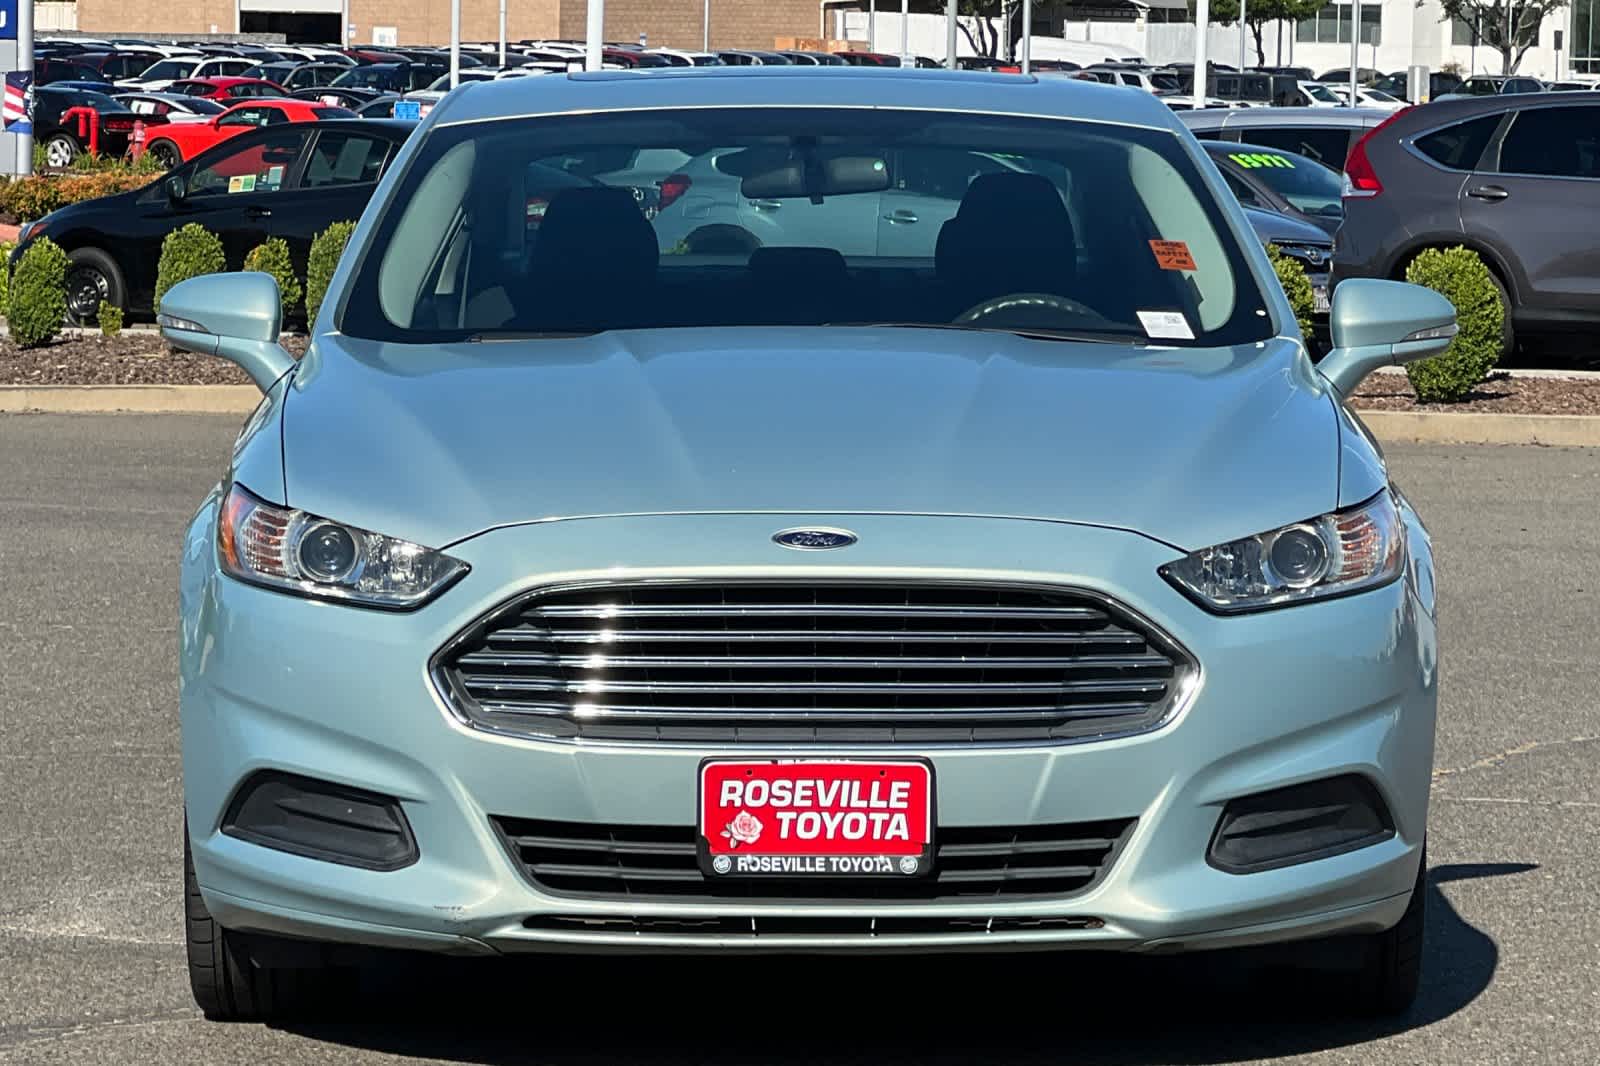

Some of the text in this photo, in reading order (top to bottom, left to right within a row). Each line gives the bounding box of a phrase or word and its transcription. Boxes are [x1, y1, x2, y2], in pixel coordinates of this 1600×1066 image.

[719, 780, 911, 809] ROSEVILLE
[776, 812, 910, 840] TOYOTA
[737, 857, 894, 872] ROSEVILLE TOYOTA
